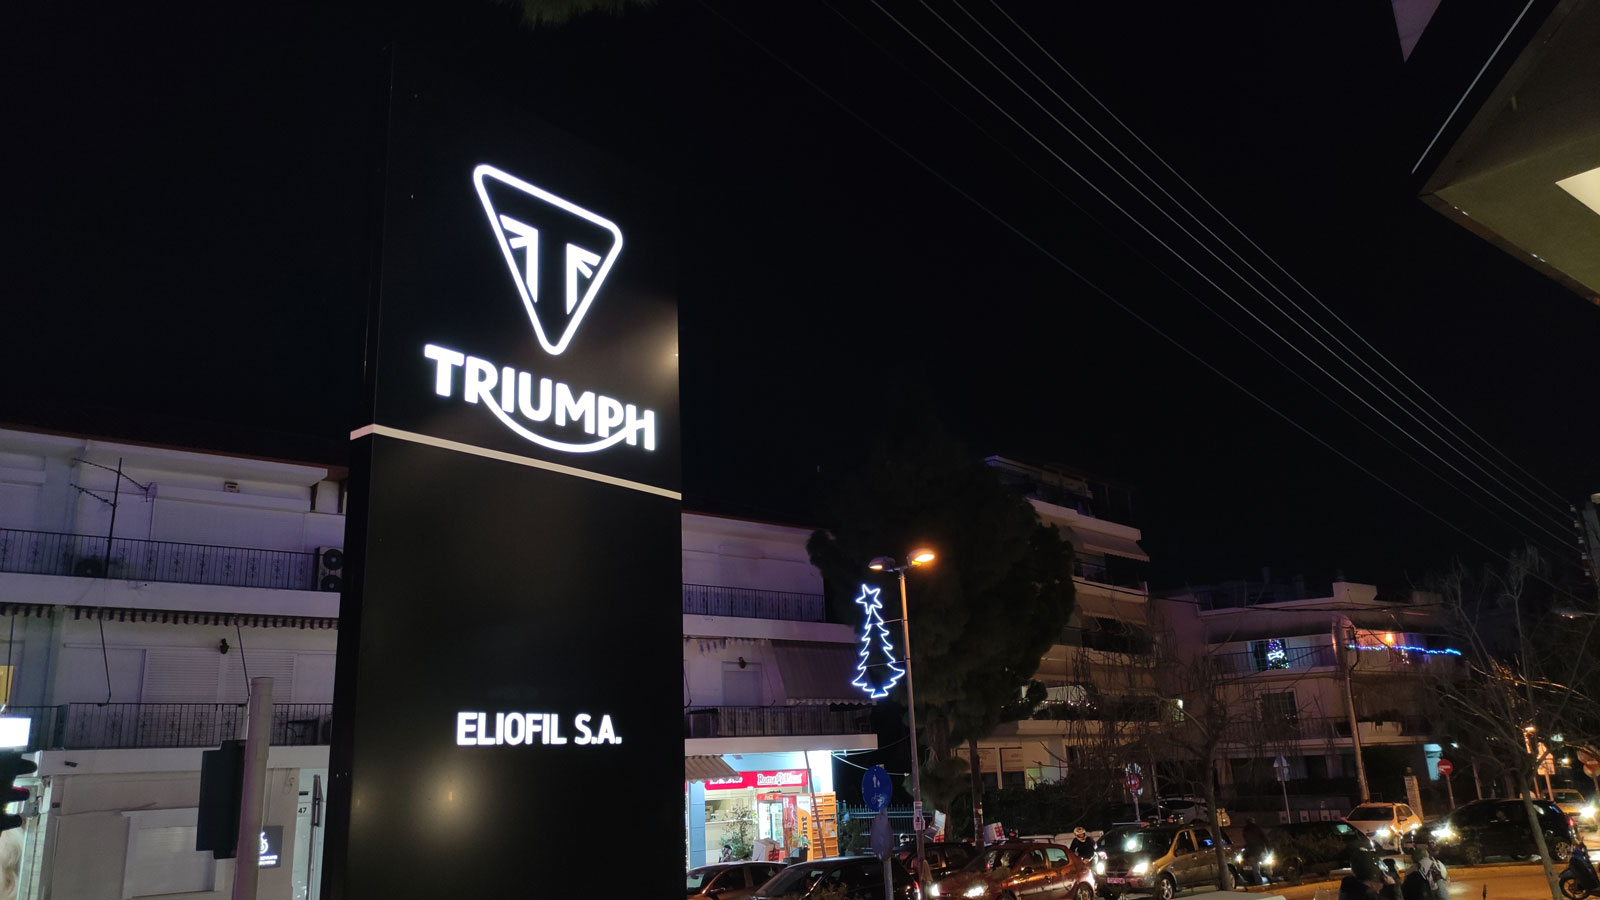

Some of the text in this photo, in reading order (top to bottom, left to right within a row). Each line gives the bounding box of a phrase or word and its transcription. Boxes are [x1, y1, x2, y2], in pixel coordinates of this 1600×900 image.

[424, 344, 655, 453] TRIUMPH
[457, 711, 623, 746] ELIOFIL S.A.
